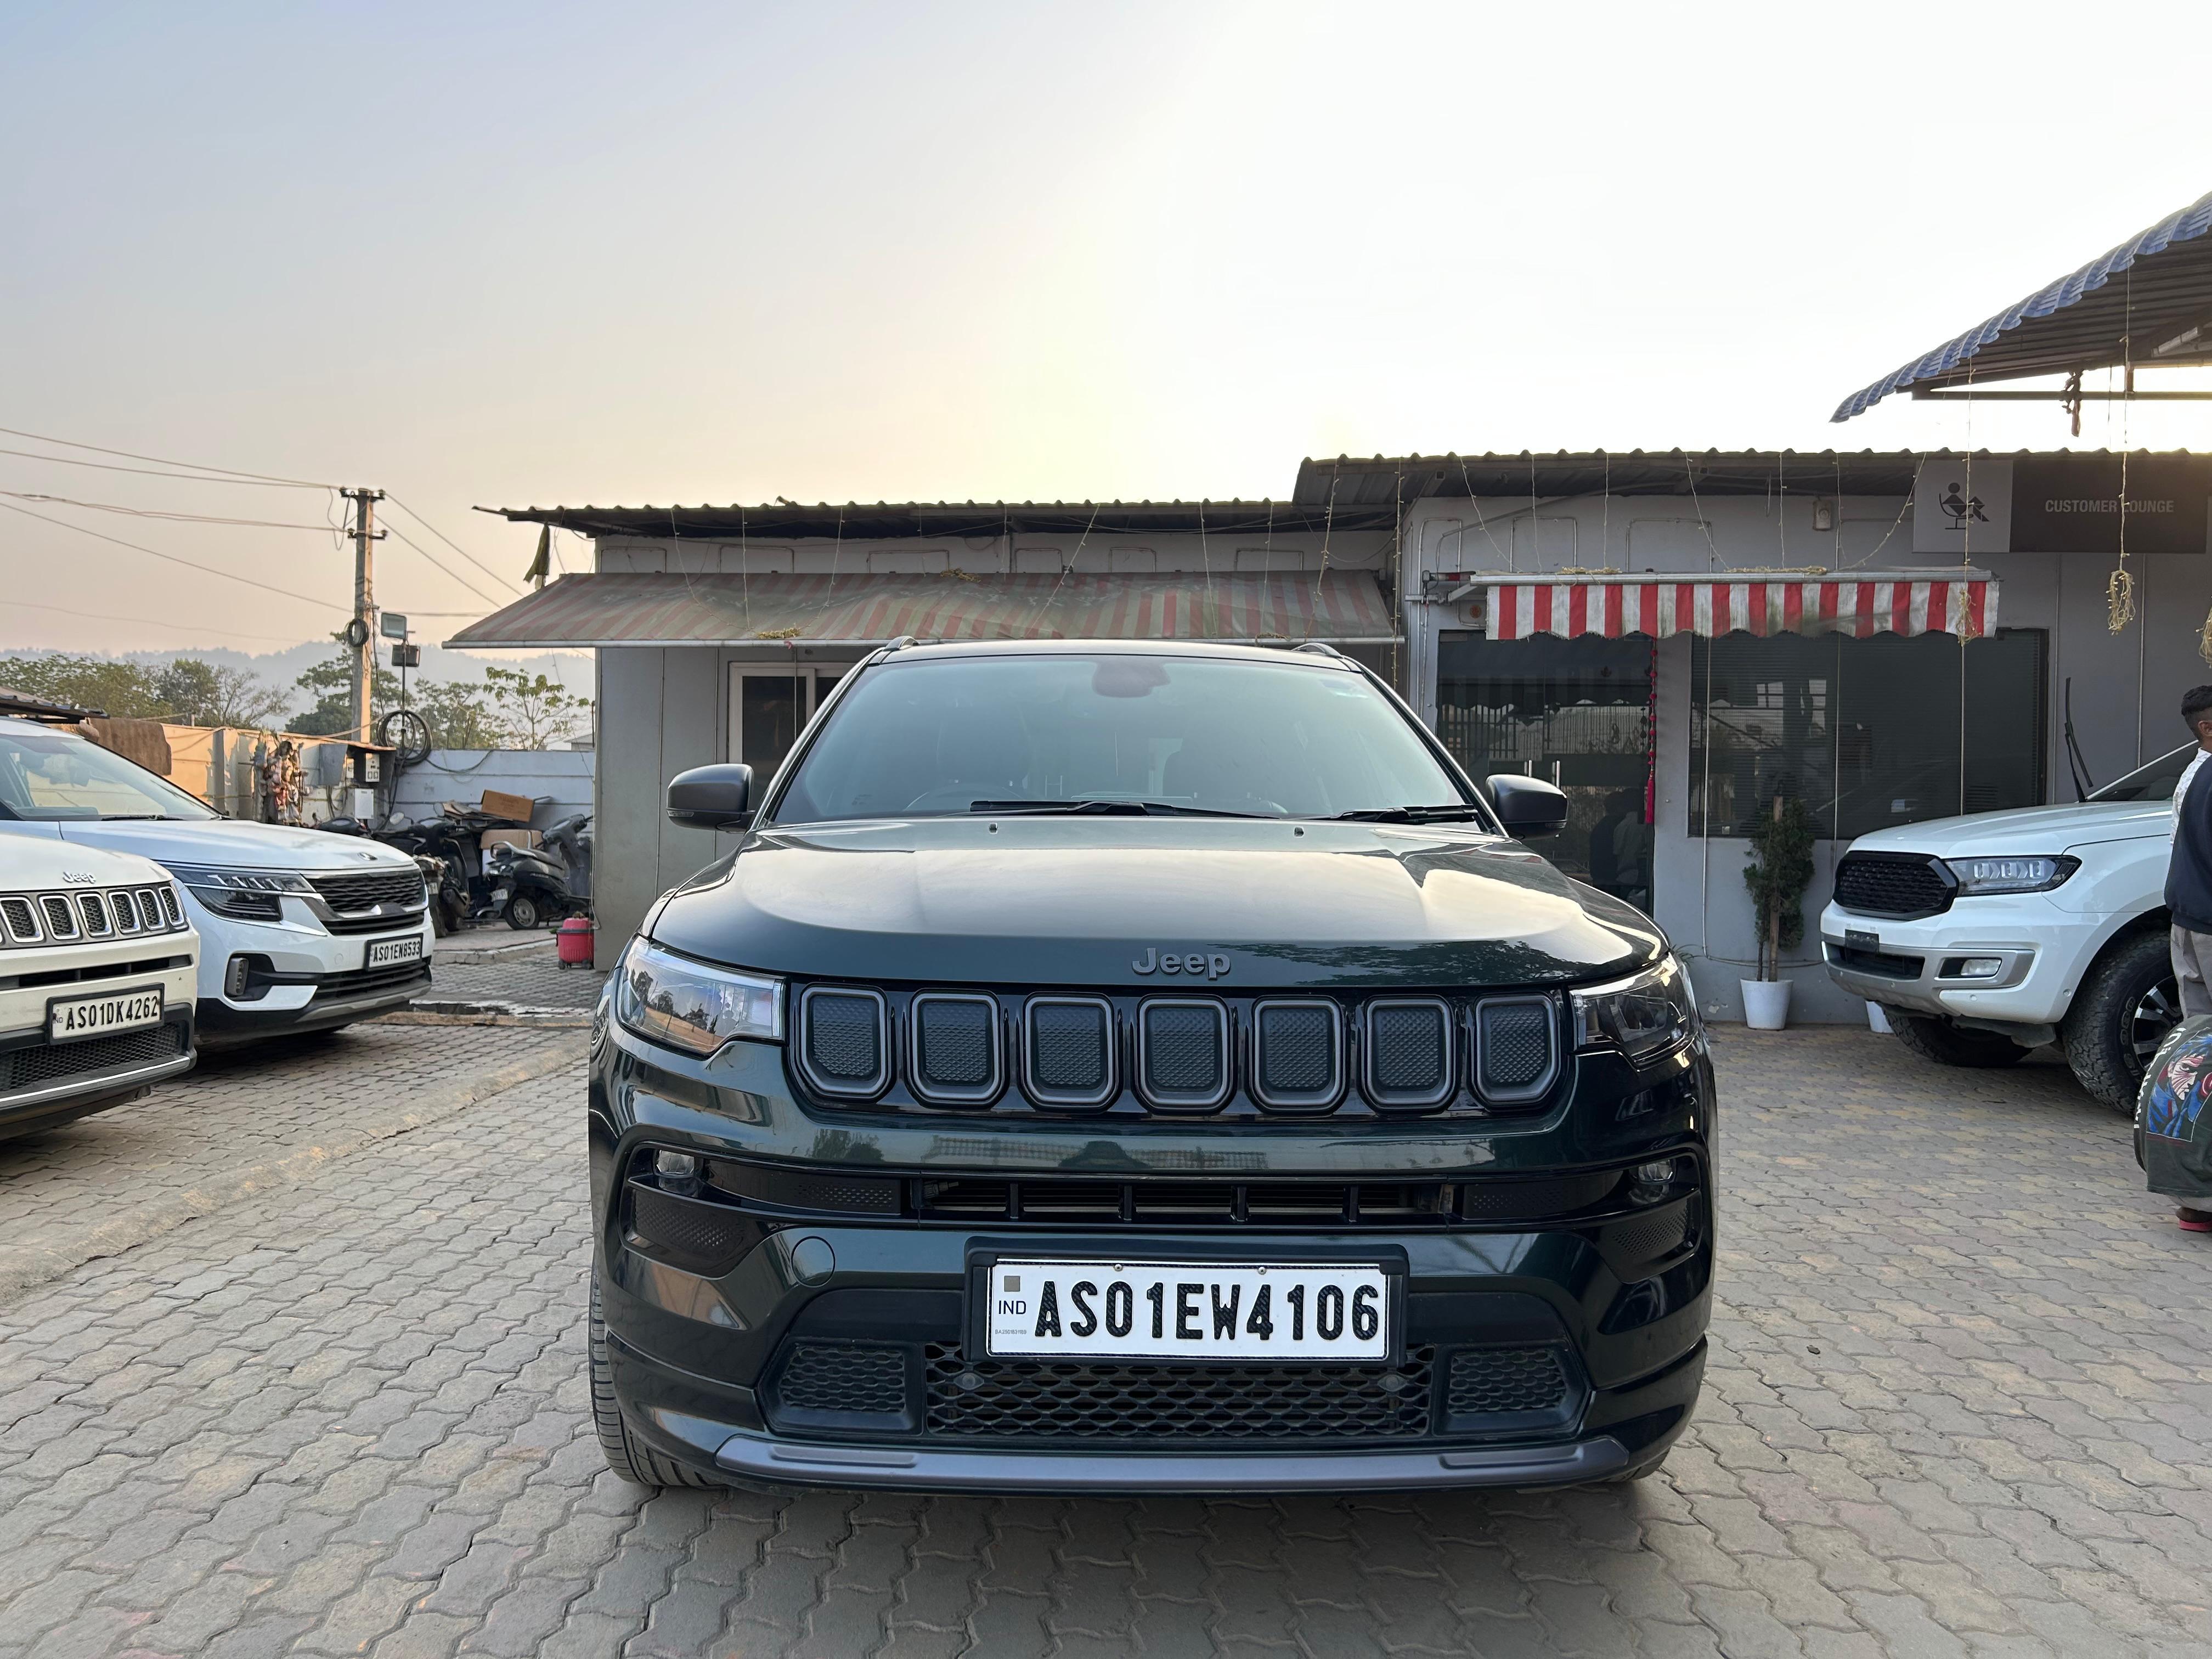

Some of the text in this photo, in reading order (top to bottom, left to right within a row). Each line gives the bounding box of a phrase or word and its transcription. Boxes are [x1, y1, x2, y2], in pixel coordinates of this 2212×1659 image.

[2045, 500, 2117, 512] CUSTOMER
[63, 871, 96, 884] Jeep
[374, 941, 420, 962] AS01EN8533
[1132, 947, 1231, 980] Jeep
[66, 996, 158, 1030] AS01DK4262
[998, 1300, 1026, 1314] IND
[1035, 1280, 1379, 1341] AS01EW4106
